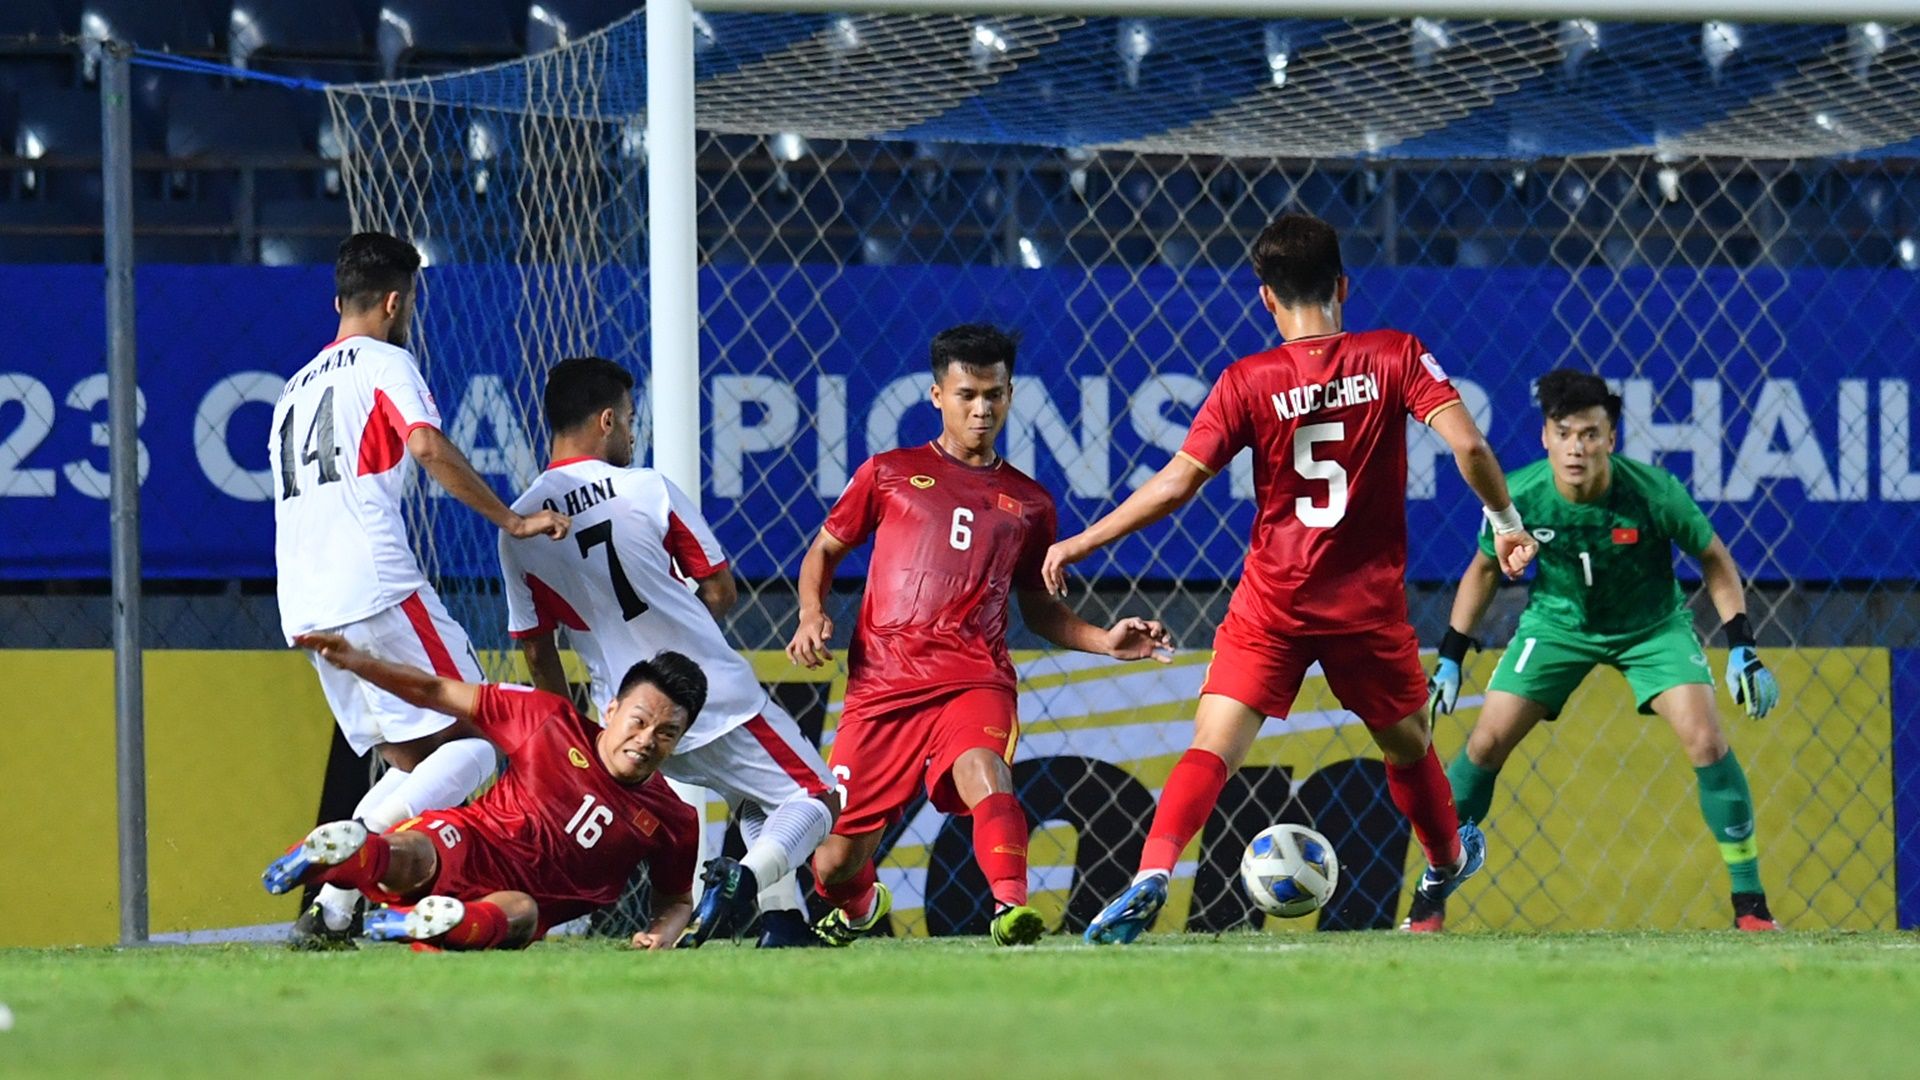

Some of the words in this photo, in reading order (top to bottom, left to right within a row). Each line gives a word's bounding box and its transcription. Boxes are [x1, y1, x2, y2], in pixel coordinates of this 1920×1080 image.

[1324, 372, 1380, 409] CHIEN
[0, 371, 151, 501] 23
[279, 385, 341, 501] 14
[1294, 421, 1348, 528] 5
[950, 507, 974, 551] 6
[575, 519, 649, 622] 7
[1579, 552, 1593, 587] 1
[1514, 638, 1537, 674] 1
[427, 819, 461, 849] 16
[564, 793, 613, 849] 16
